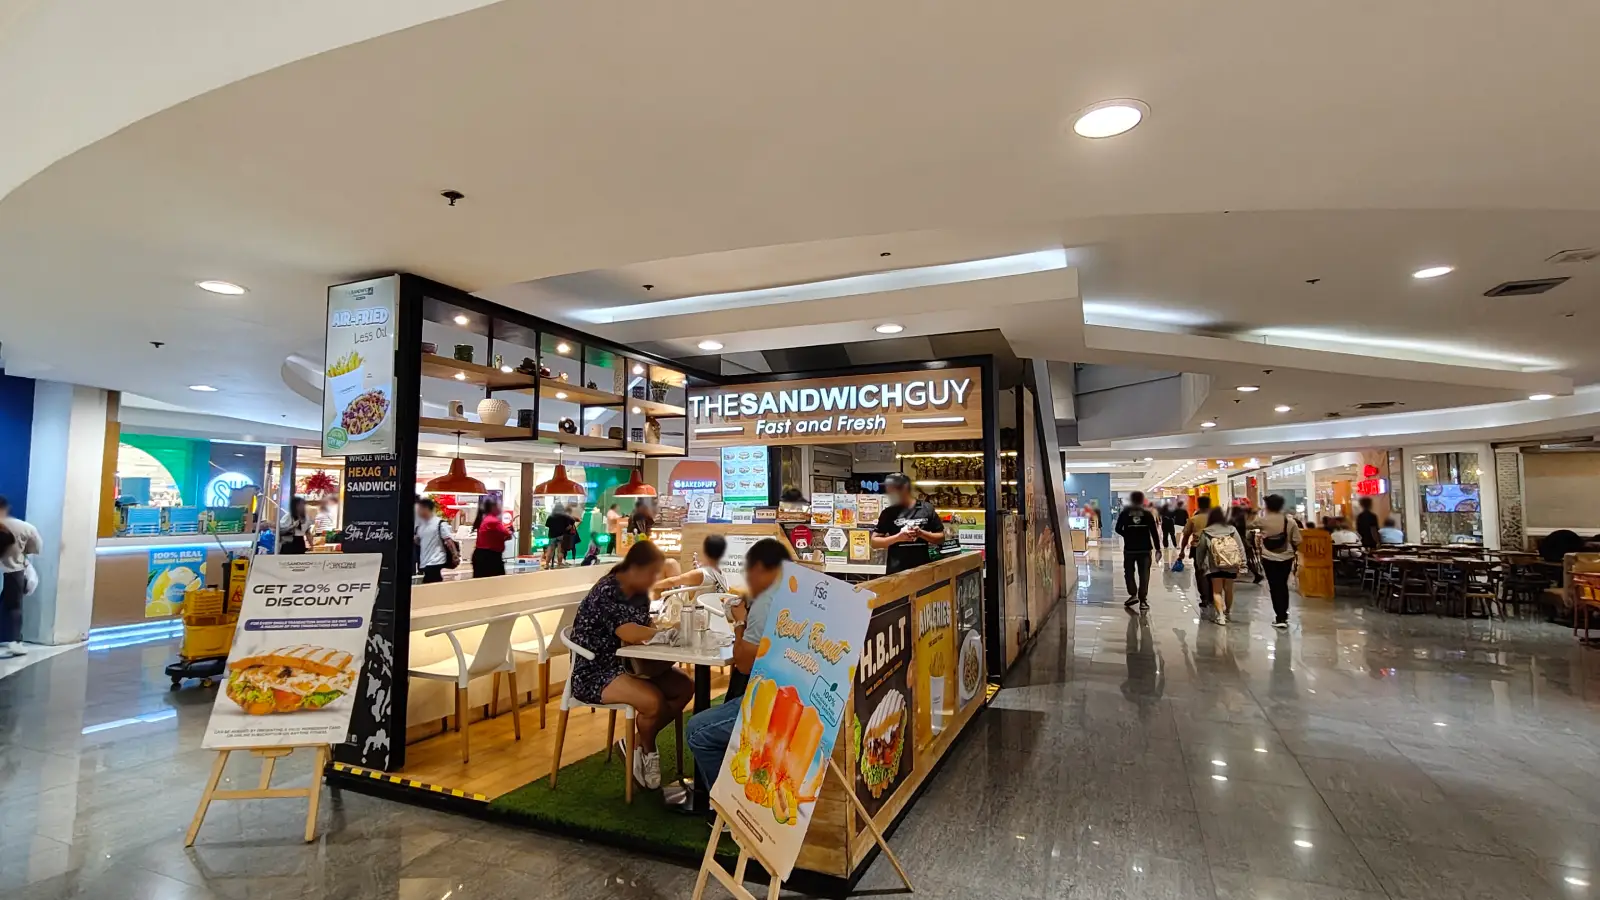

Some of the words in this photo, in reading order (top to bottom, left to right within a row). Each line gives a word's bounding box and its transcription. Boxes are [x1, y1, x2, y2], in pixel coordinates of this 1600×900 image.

[332, 307, 390, 328] AIR-FRIED
[354, 331, 374, 344] Less
[756, 418, 792, 435] Fast
[796, 415, 834, 433] and
[837, 414, 886, 431] Fresh
[347, 481, 396, 492] SANDWICH
[153, 551, 179, 560] 100%
[179, 550, 203, 558] REAL
[252, 584, 288, 595] GET
[291, 583, 331, 594] 20%
[336, 582, 372, 593] OFF
[813, 586, 828, 601] TSG
[265, 595, 353, 607] DISCOUNT
[823, 688, 836, 707] 100%
